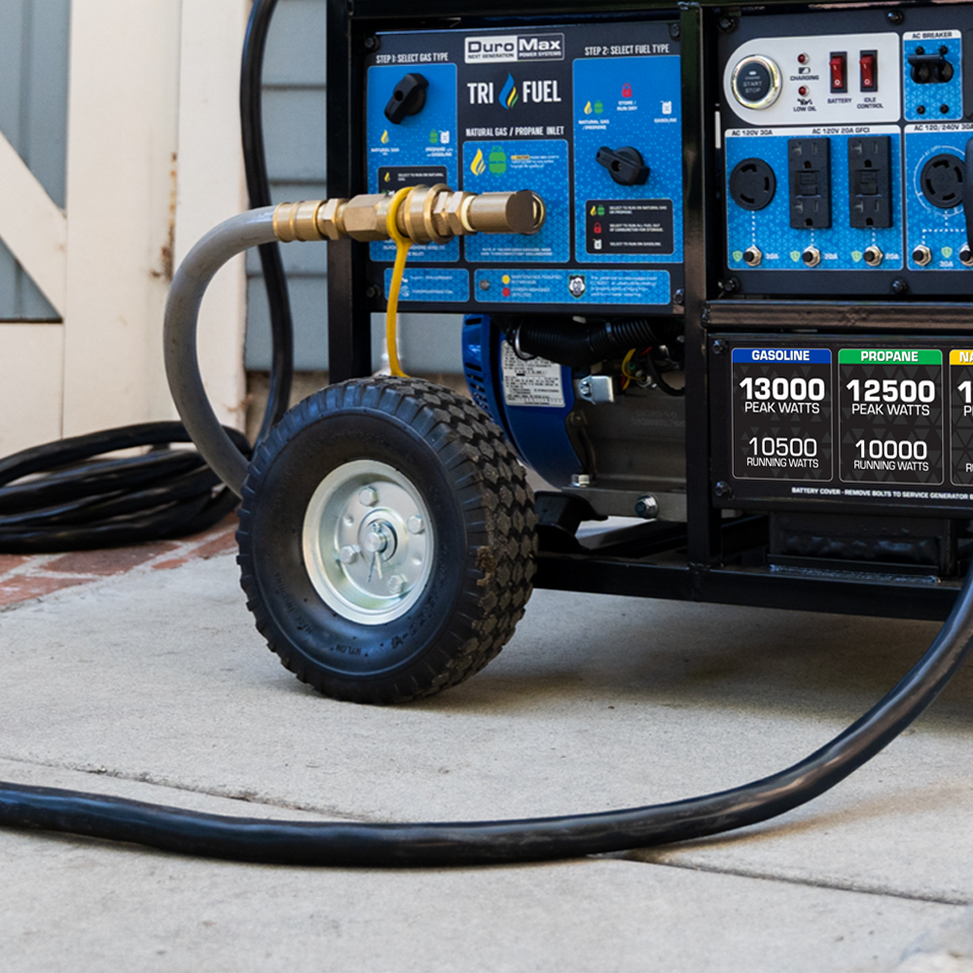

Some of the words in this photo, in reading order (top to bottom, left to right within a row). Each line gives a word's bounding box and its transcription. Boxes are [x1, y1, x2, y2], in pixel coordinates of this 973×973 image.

[922, 31, 953, 39] BREAKER
[584, 46, 602, 56] STEP
[602, 46, 609, 55] 2:
[610, 45, 634, 55] SELECT
[635, 44, 651, 54] FUEL
[652, 43, 670, 54] TYPE
[376, 54, 391, 64] STEP
[397, 53, 419, 63] SELECT
[419, 53, 432, 62] GAS
[433, 52, 449, 61] TYPE
[467, 82, 494, 104] TRI
[522, 80, 562, 103] FUEL
[466, 128, 494, 137] NATURAL
[494, 127, 508, 136] GAS
[515, 126, 544, 136] PROPANE
[546, 126, 565, 135] INLET
[751, 350, 810, 361] GASOLINE
[860, 351, 919, 362] PROPANE
[739, 377, 825, 401] 13000
[846, 379, 935, 403] 12500
[744, 401, 776, 413] PEAK
[778, 402, 820, 414] WATTS
[852, 403, 884, 415] PEAK
[885, 404, 930, 416] WATTS
[749, 437, 817, 457] 10500
[855, 439, 928, 460] 10000
[746, 457, 787, 468] RUNNING
[788, 458, 819, 468] WATTS
[853, 460, 896, 471] RUNNING
[897, 461, 929, 472] WATTS
[791, 486, 819, 494] BATTERY
[820, 487, 841, 495] COVER
[844, 488, 871, 497] REMOVE
[902, 491, 928, 499] SERVICE
[929, 492, 968, 500] GENERATOR
